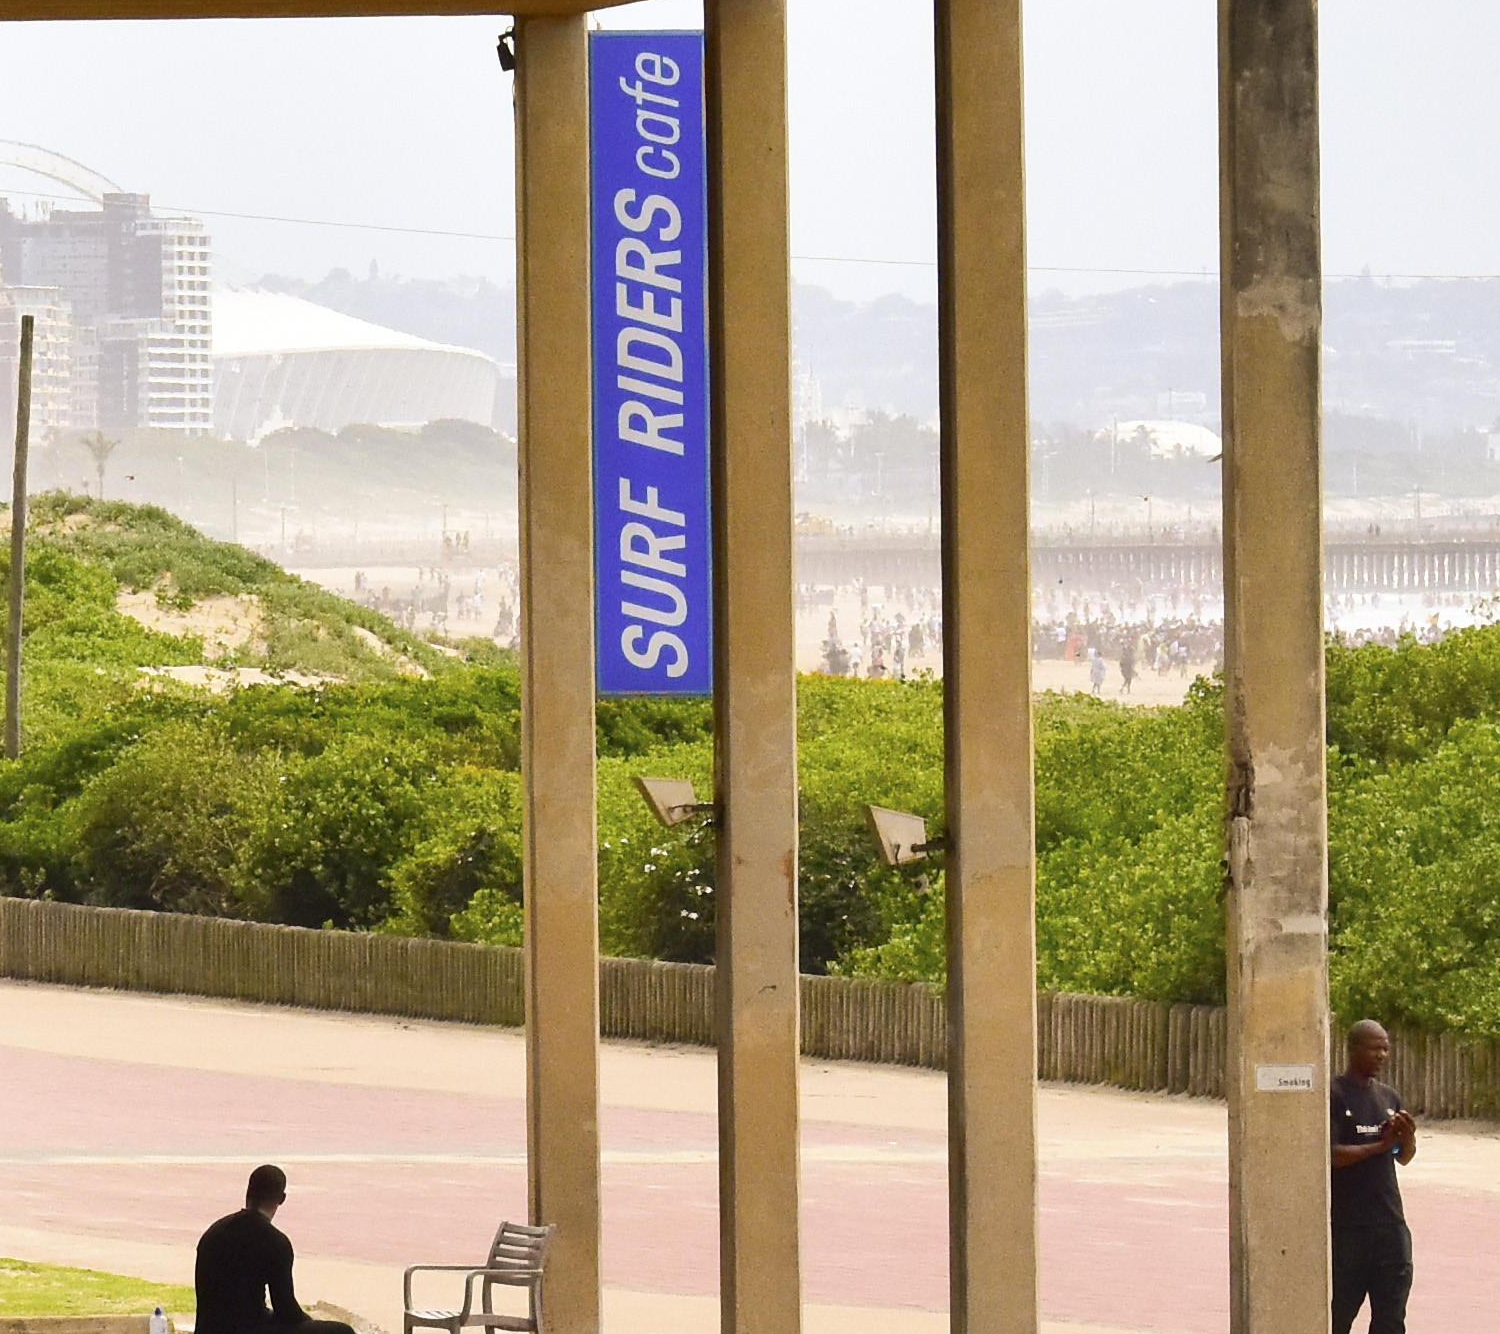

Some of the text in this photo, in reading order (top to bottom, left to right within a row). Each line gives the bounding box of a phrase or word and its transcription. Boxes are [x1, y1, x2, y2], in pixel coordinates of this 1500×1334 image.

[614, 52, 689, 677] SURF RIDERS cafe
[1278, 1078, 1311, 1088] Smoking
